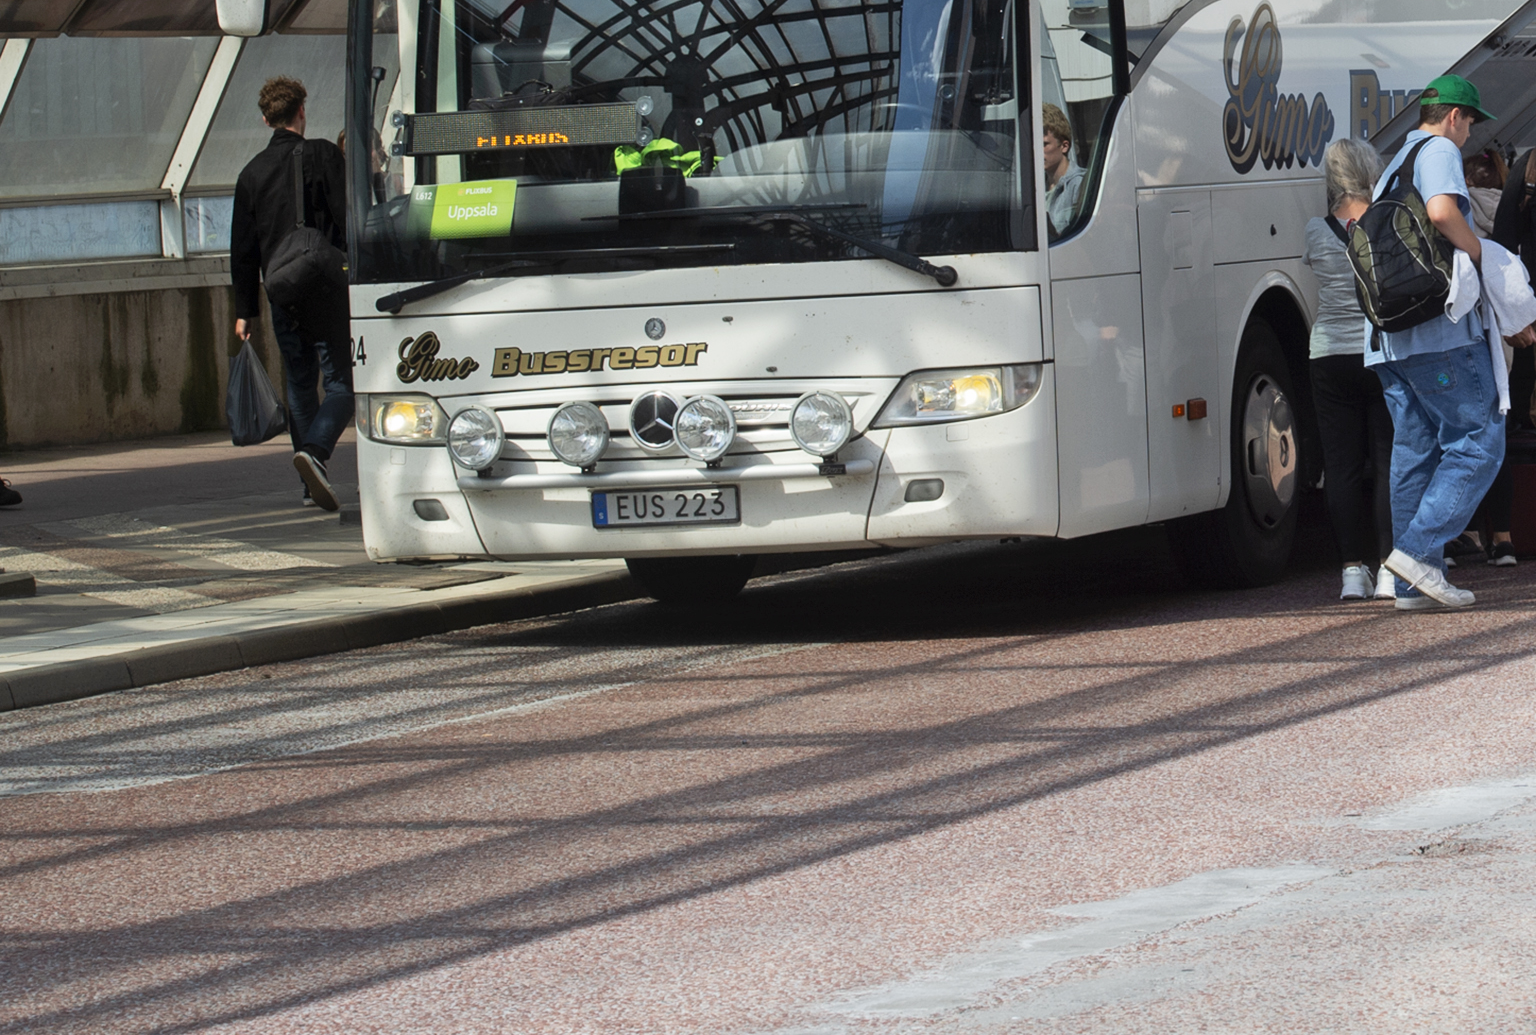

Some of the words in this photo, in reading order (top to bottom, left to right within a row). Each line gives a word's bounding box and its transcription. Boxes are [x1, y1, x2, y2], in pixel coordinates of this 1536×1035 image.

[1223, 0, 1335, 175] Gimo
[415, 191, 432, 201] L612
[465, 187, 493, 195] FLIXBUS
[448, 203, 498, 220] Uppsala
[396, 331, 480, 384] Gimo
[491, 342, 708, 378] Bussresor
[616, 494, 665, 520] EUS
[674, 491, 725, 517] 223
